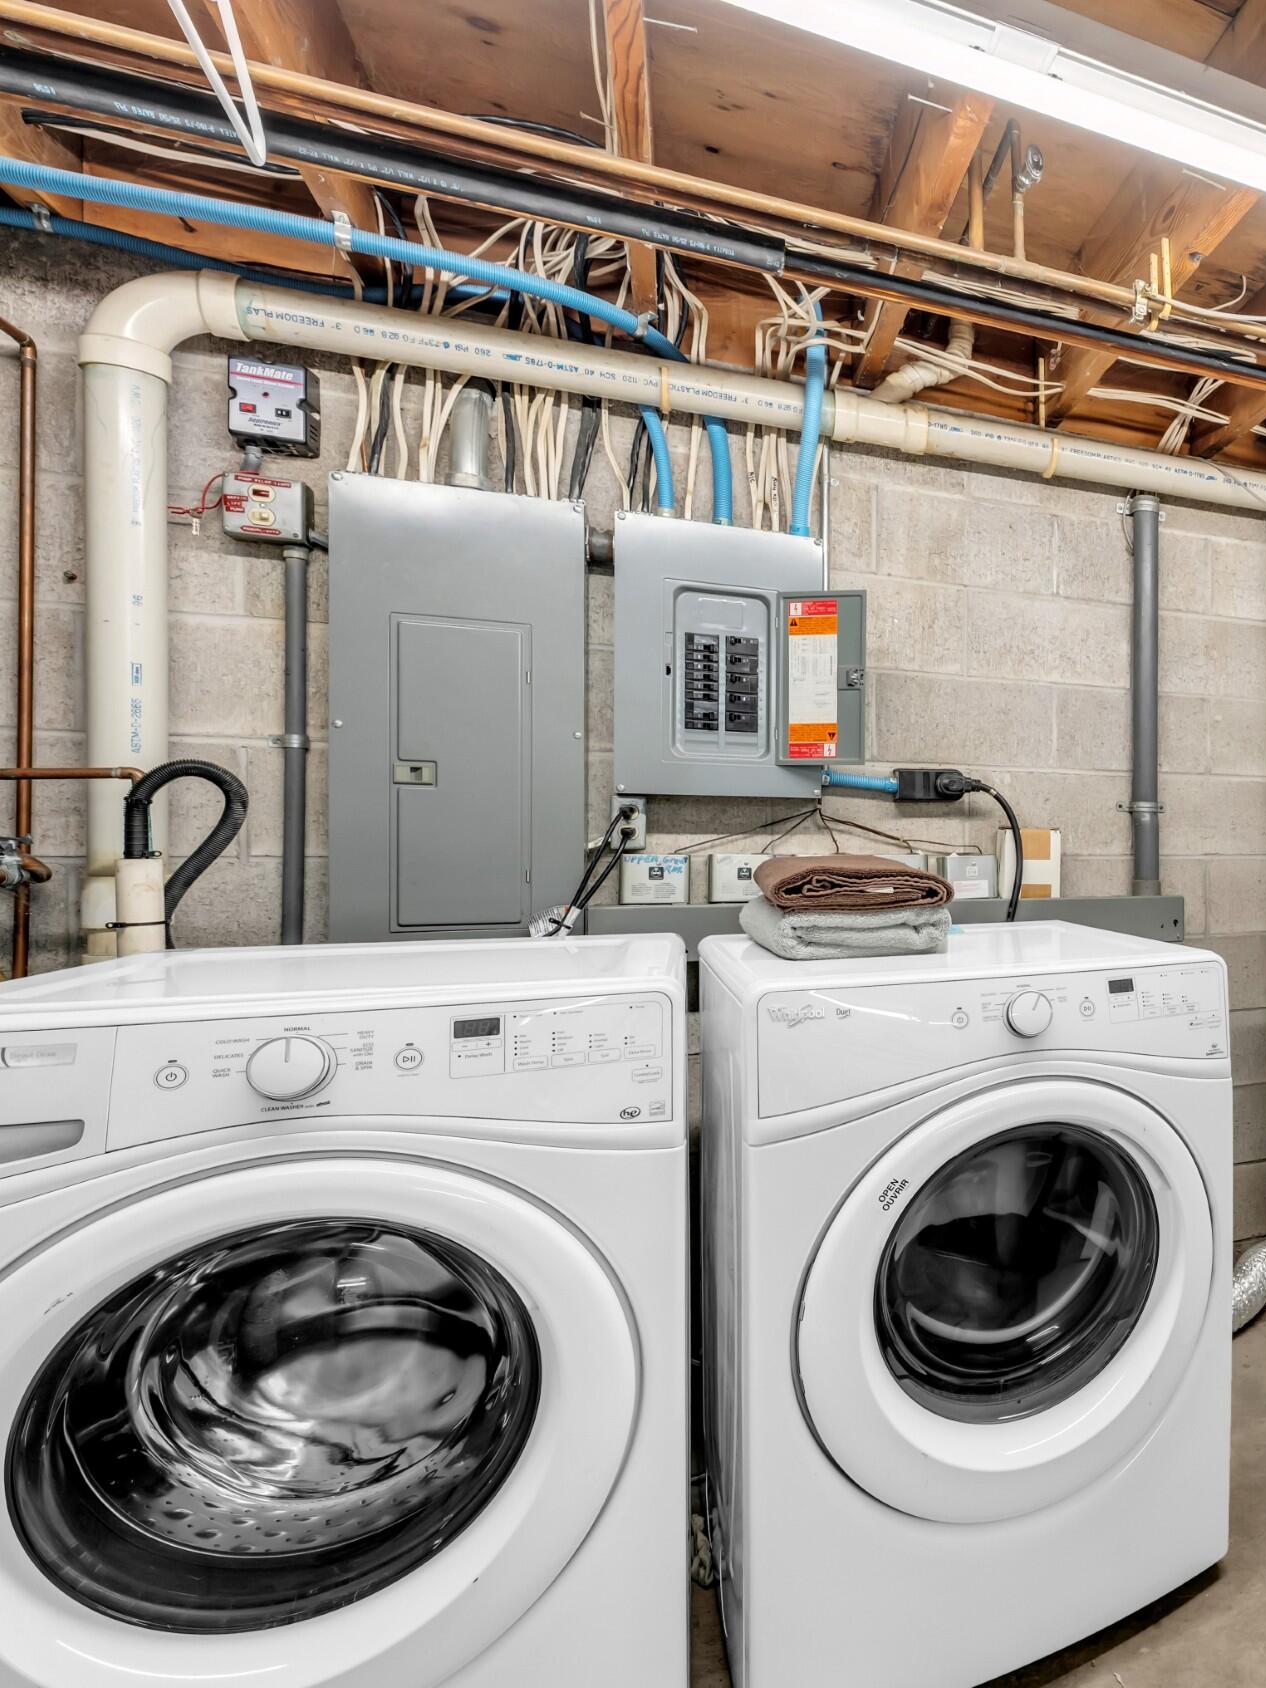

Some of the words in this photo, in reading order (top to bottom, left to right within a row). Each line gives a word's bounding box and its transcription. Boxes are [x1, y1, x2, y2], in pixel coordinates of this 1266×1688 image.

[275, 311, 324, 327] FREEDOM
[236, 362, 294, 381] TankMate
[700, 389, 736, 401] FREEDOM
[768, 1006, 825, 1025] Whirlpool
[879, 1178, 899, 1203] OPEN
